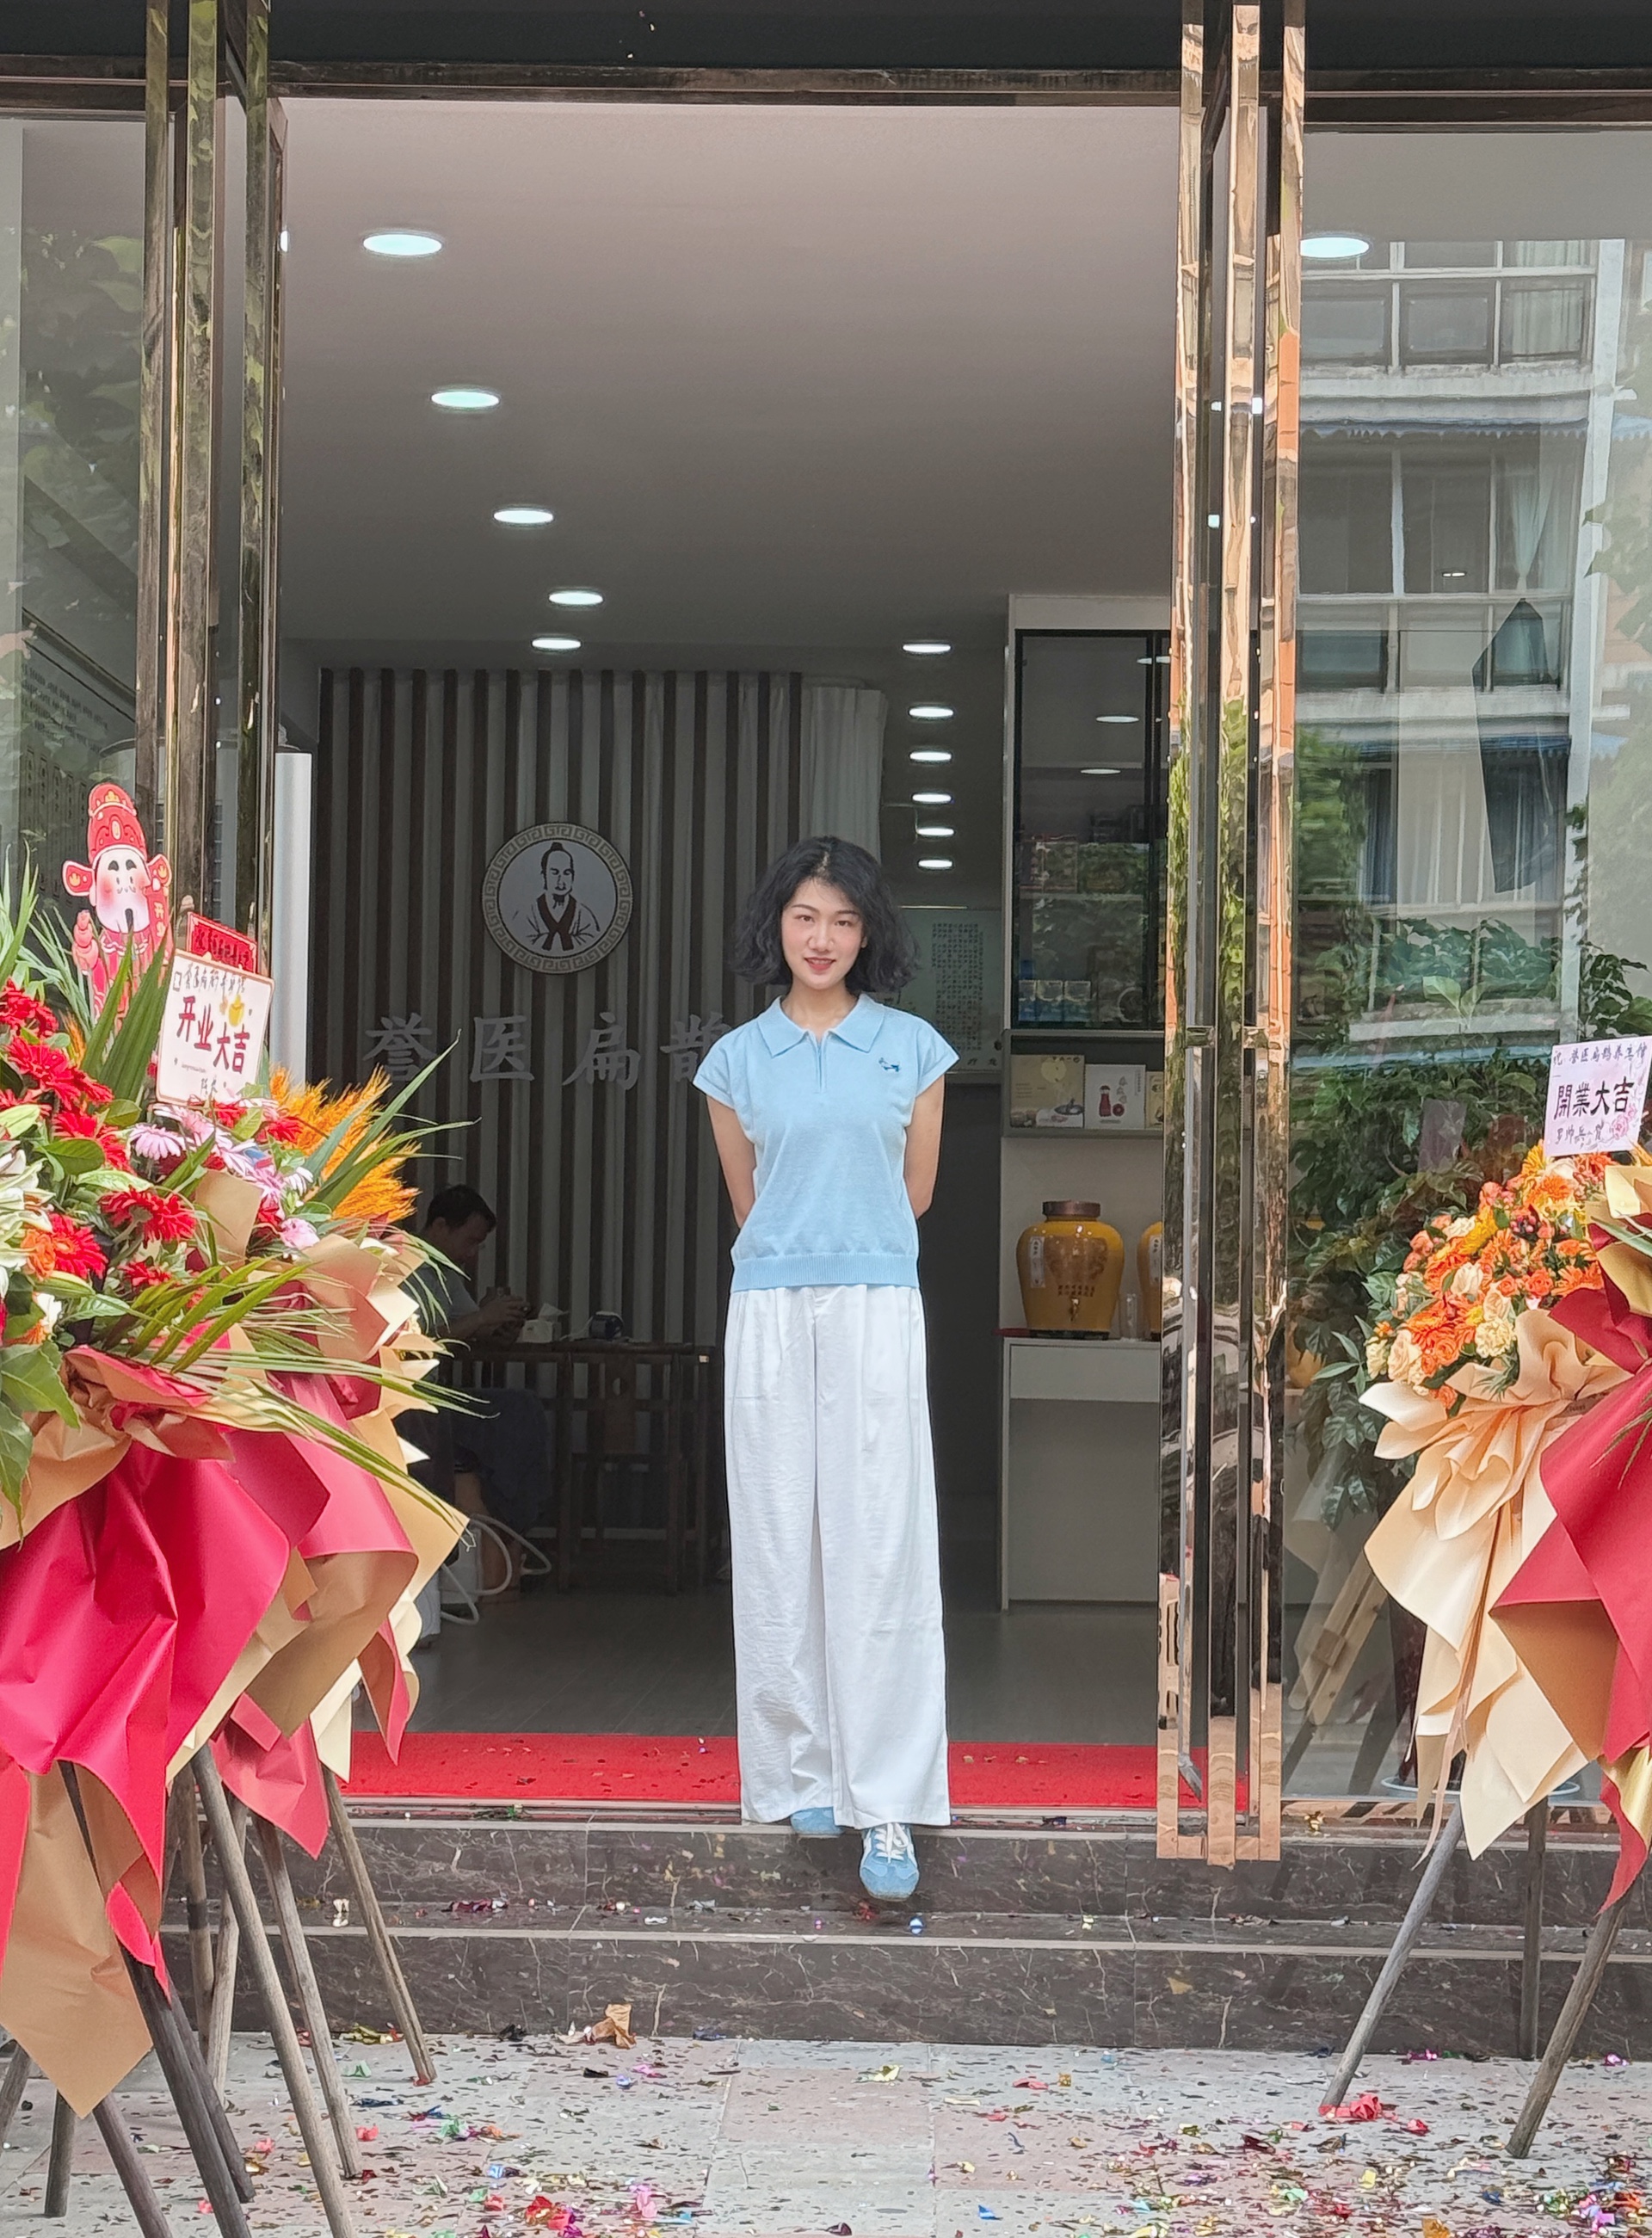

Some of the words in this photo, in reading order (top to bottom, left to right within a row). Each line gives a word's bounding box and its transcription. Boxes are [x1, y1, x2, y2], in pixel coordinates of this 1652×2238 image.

[176, 995, 250, 1075] 开业大吉
[1553, 1075, 1635, 1120] 開業大吉
